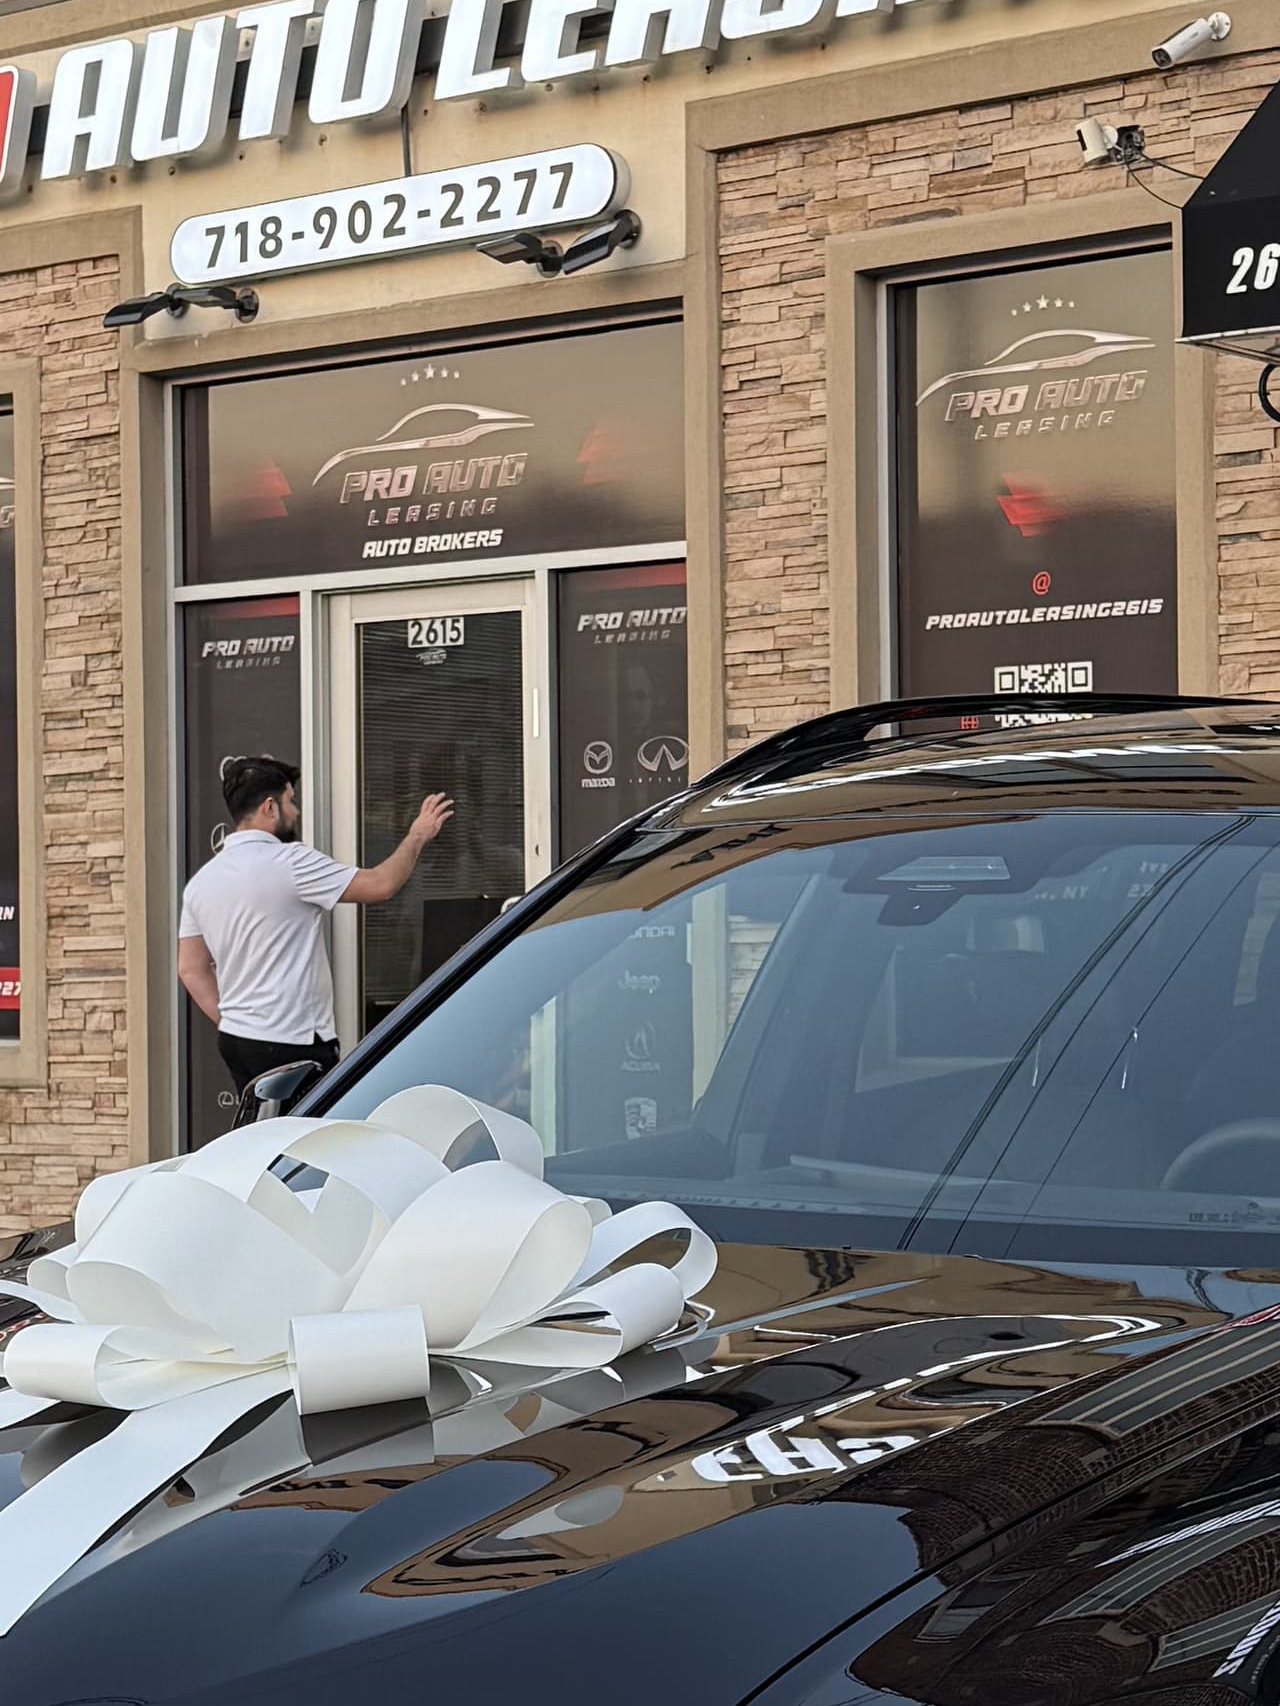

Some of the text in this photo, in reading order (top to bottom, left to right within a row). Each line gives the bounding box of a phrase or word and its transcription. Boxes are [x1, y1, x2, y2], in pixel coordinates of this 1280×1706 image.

[204, 163, 575, 270] 718-902-2277
[944, 370, 1148, 421] PRO AUTO
[974, 410, 1115, 440] LEASING
[339, 452, 528, 504] PRO AUTO
[368, 497, 498, 527] LEASING
[362, 529, 503, 559] AUTO BROKERS
[577, 606, 687, 631] PRO AUTO
[926, 598, 1163, 630] PROAUTOLEASING2615
[201, 635, 295, 658] PRO AUTO
[411, 618, 461, 645] 2615
